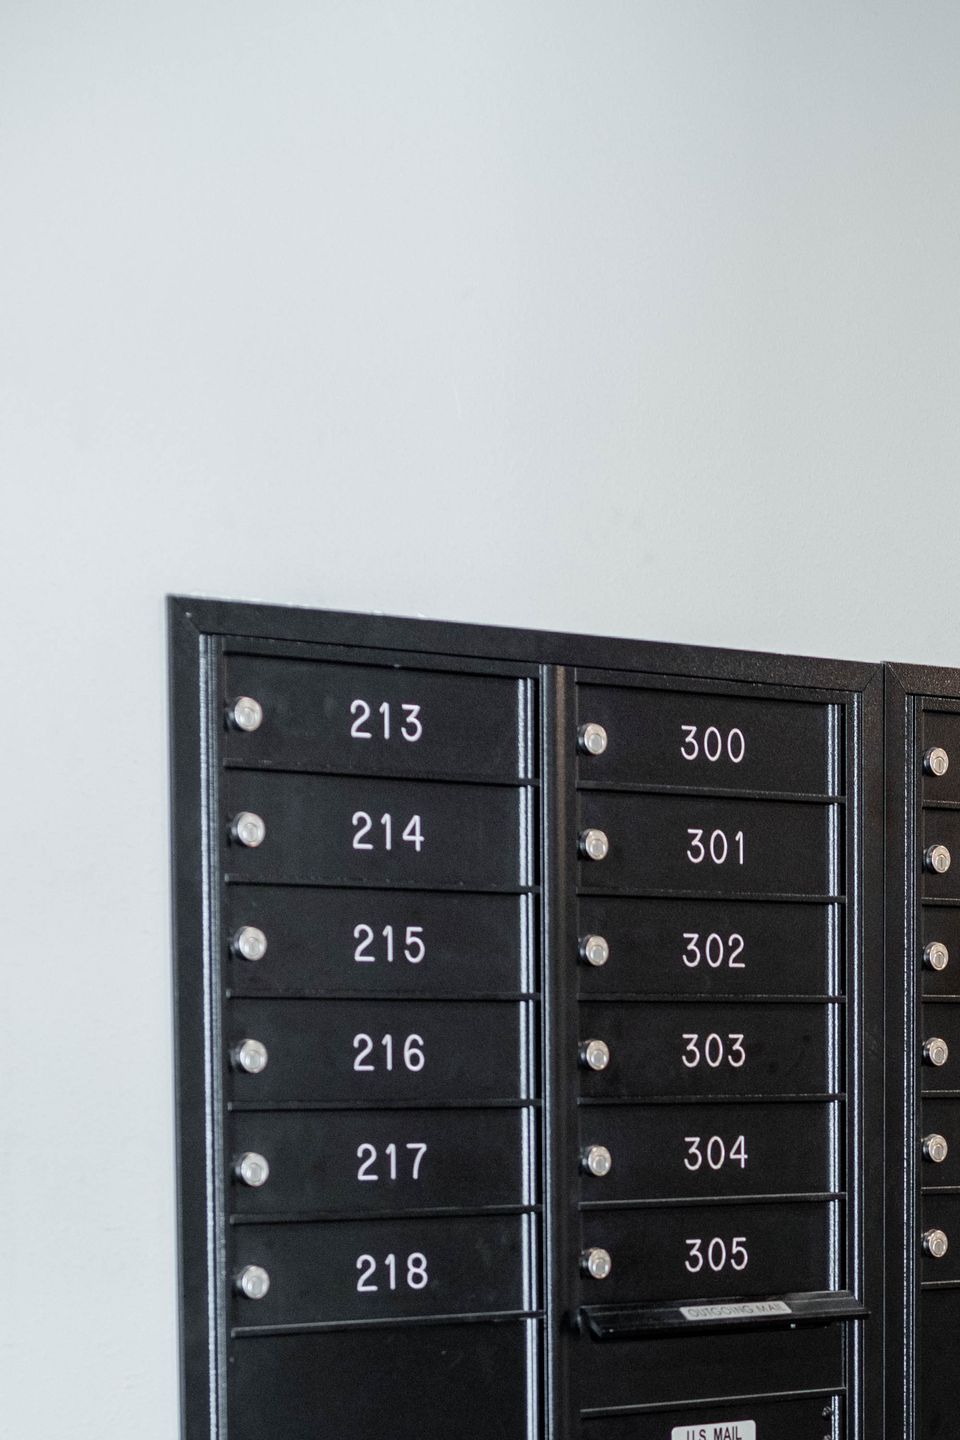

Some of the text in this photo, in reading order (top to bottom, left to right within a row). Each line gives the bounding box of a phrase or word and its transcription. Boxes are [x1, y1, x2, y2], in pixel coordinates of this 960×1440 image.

[349, 698, 423, 743] 213
[680, 724, 746, 764] 300
[351, 810, 425, 853] 214
[686, 828, 744, 865] 301
[353, 923, 426, 964] 215
[682, 932, 746, 969] 302
[352, 1032, 426, 1072] 216
[681, 1032, 746, 1068] 303
[356, 1142, 428, 1182] 217
[683, 1134, 749, 1171] 304
[355, 1251, 429, 1293] 218
[684, 1236, 749, 1273] 305
[687, 1305, 754, 1318] OUTGOING
